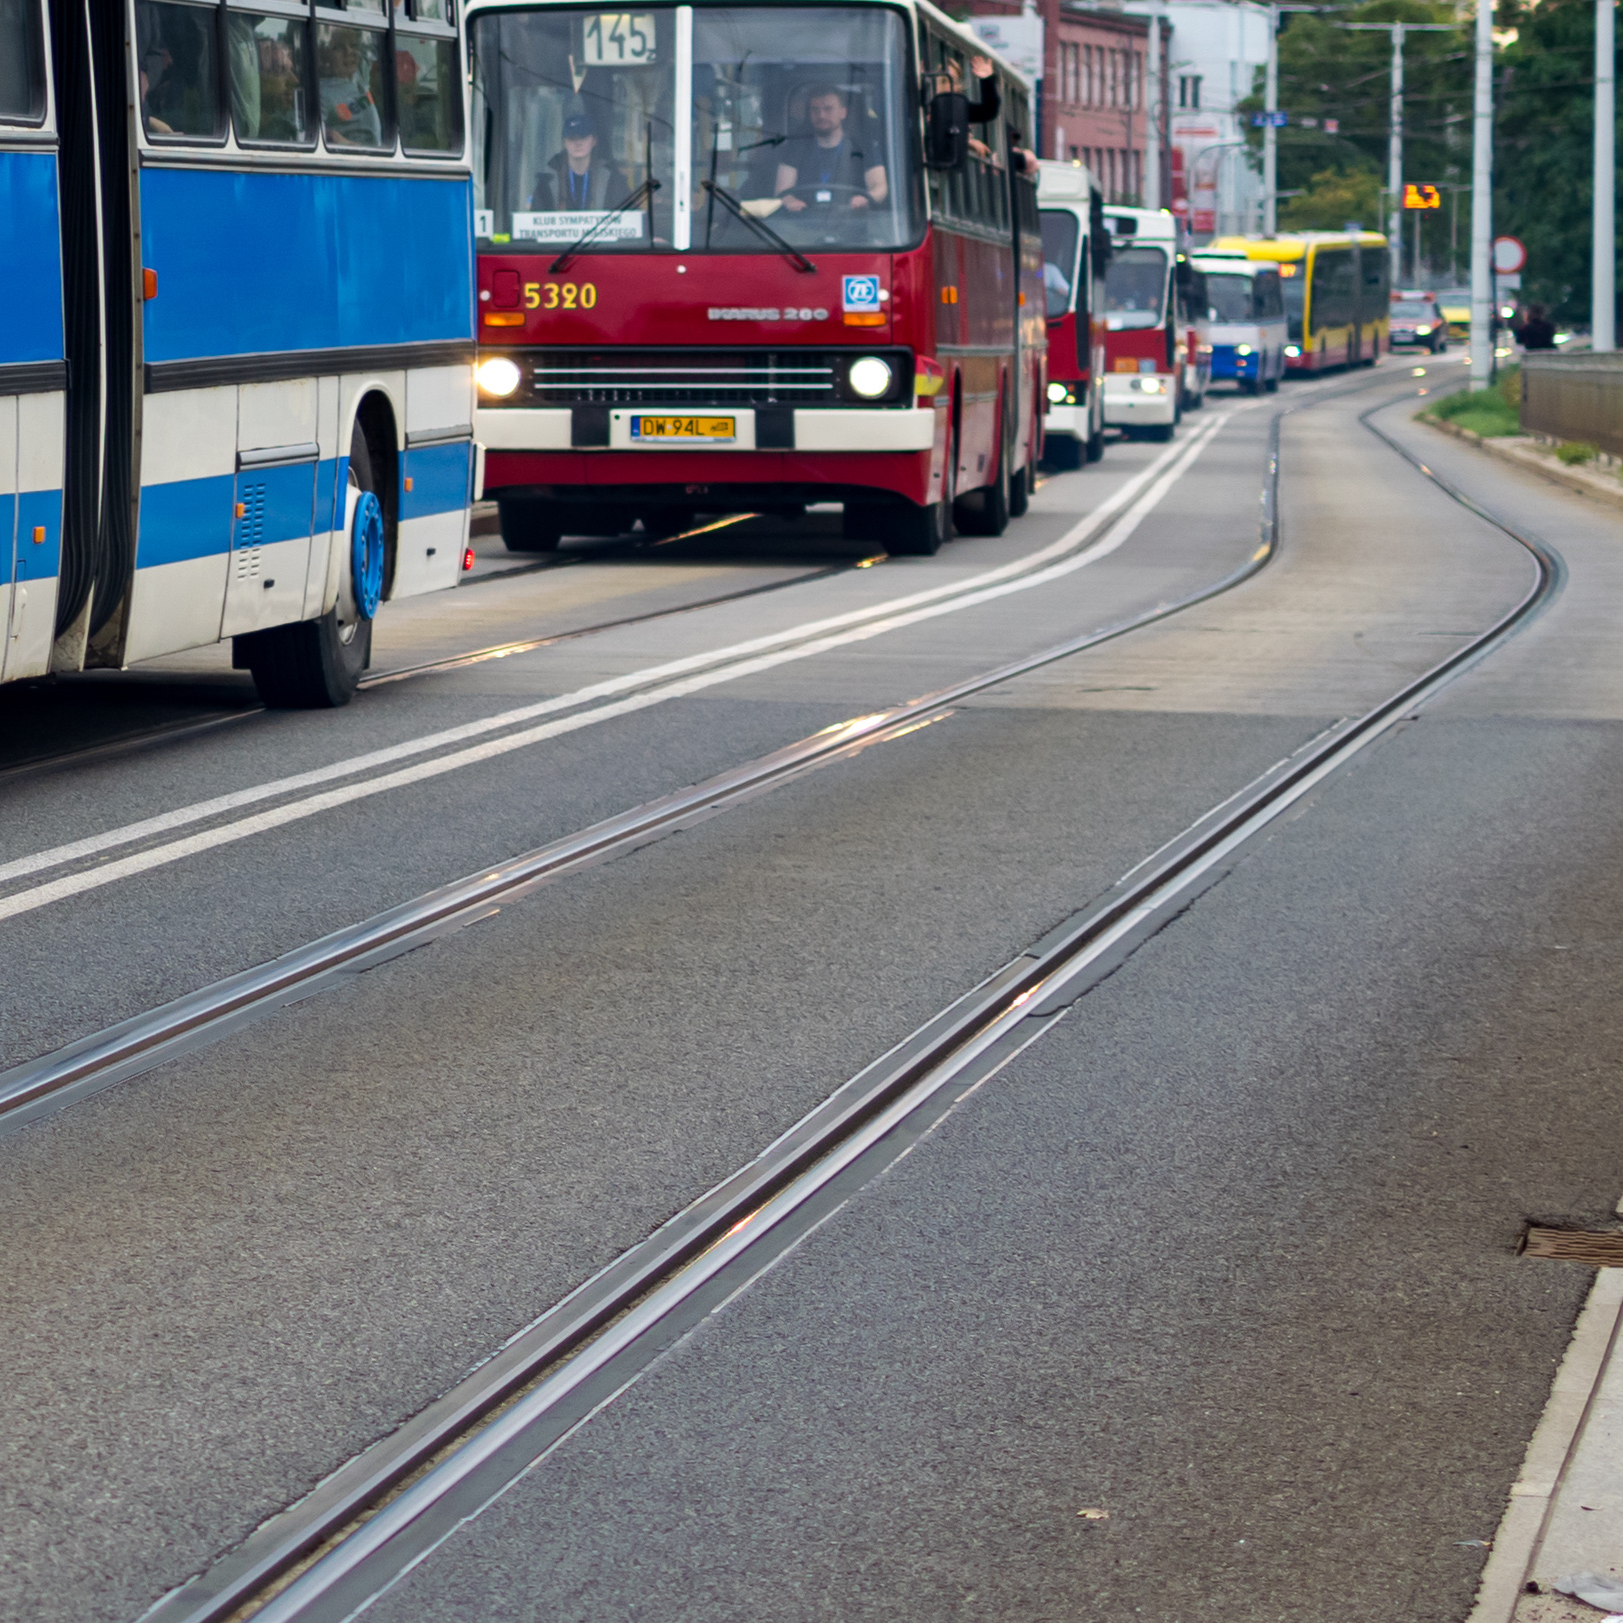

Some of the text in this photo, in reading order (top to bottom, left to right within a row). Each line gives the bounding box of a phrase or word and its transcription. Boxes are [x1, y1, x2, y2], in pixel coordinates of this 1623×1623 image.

[586, 13, 646, 60] 145
[480, 215, 486, 232] 1
[533, 216, 556, 225] KLUB
[520, 228, 579, 240] TRANSPORTU
[524, 282, 597, 309] 5320
[643, 418, 705, 436] DW 94L
